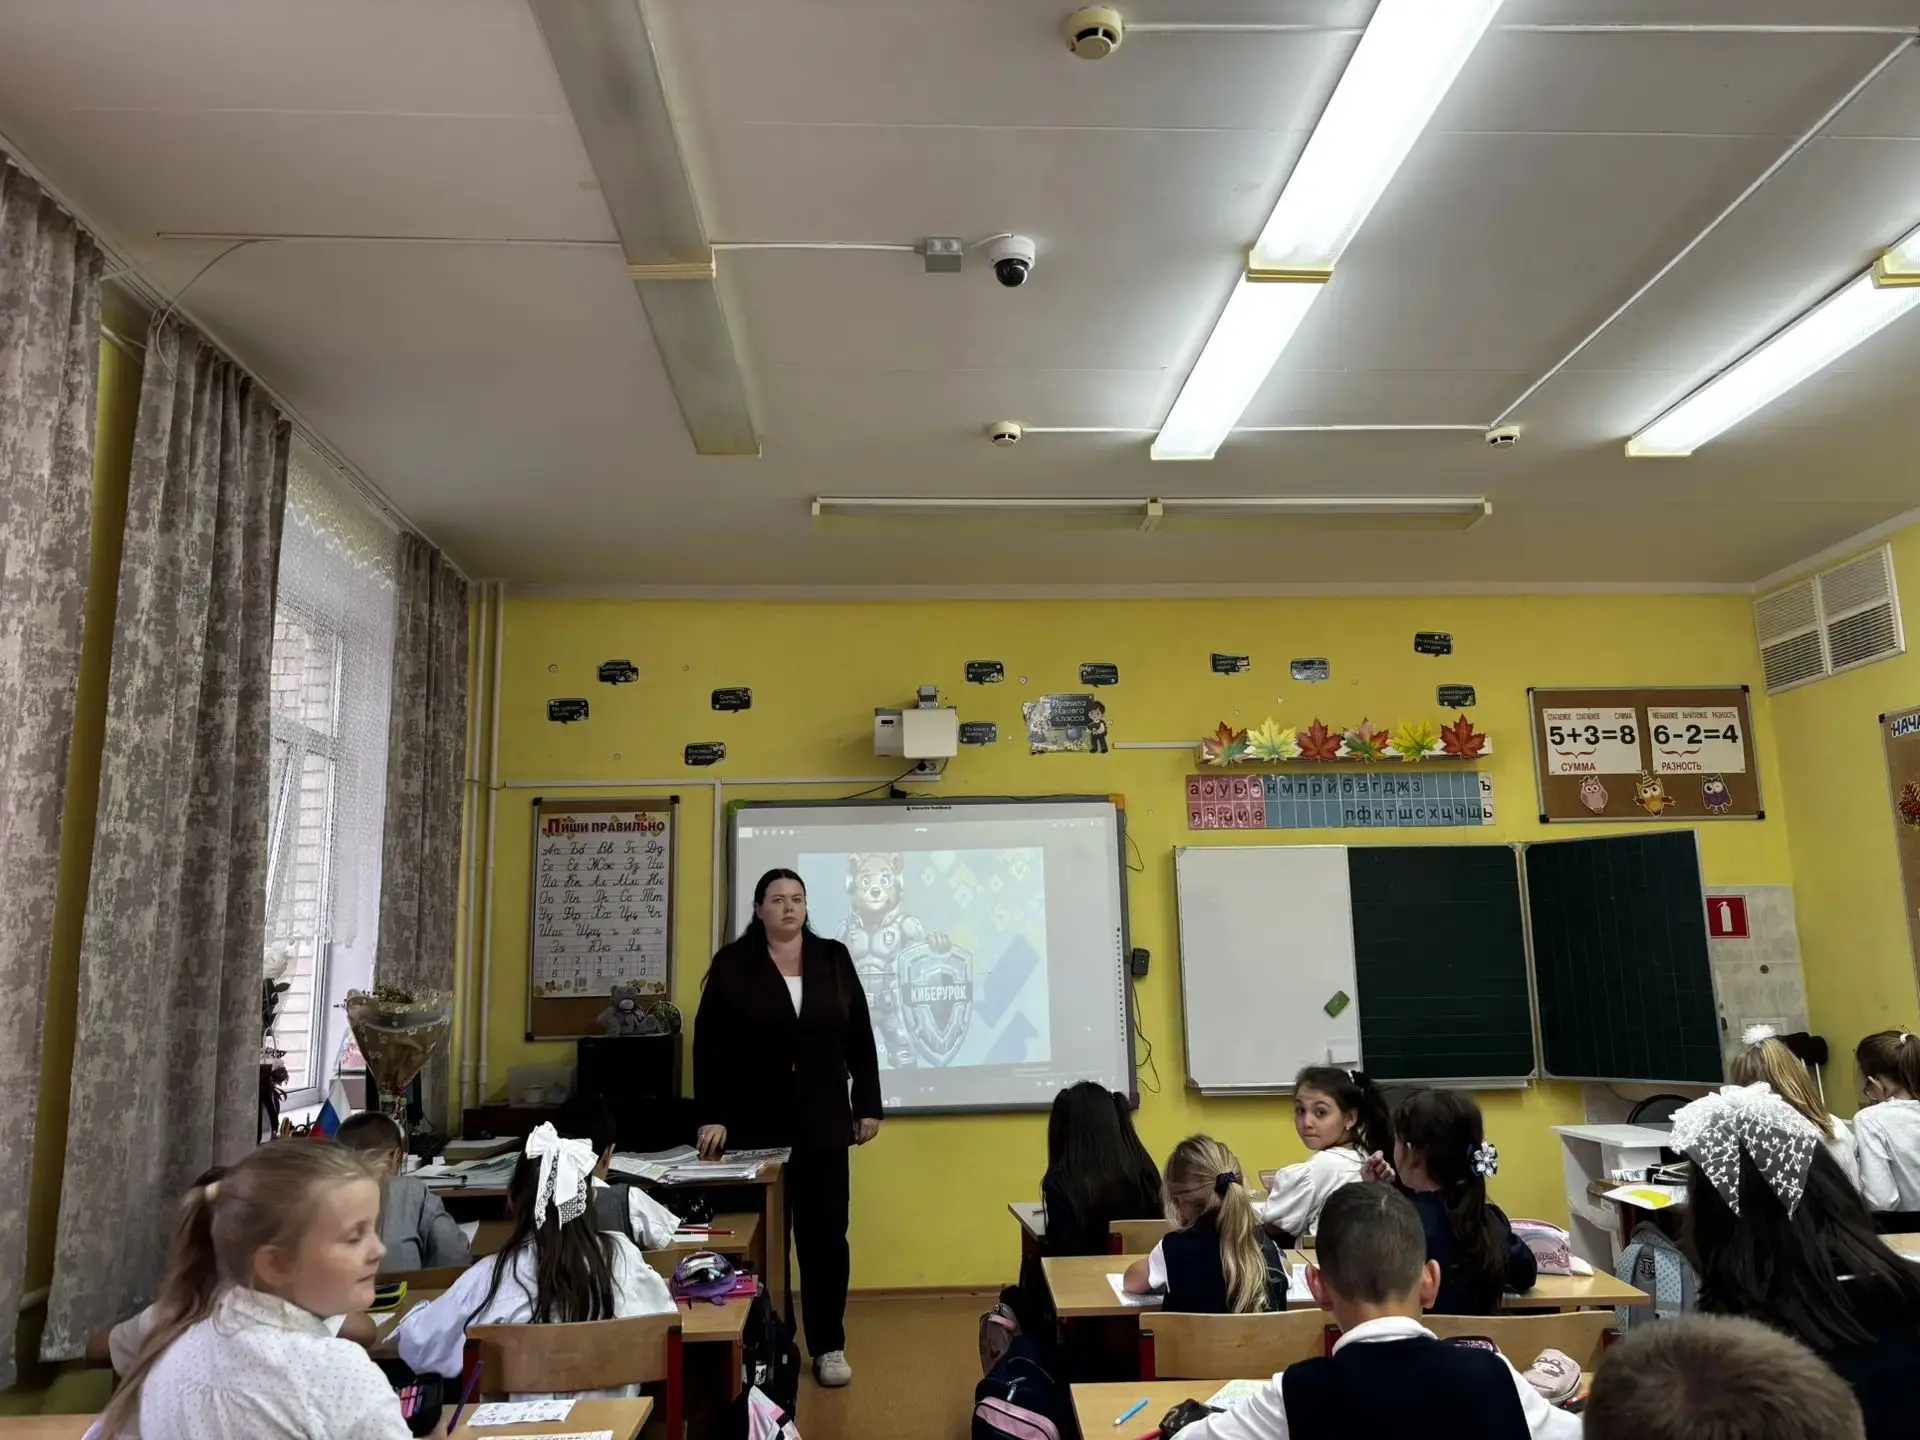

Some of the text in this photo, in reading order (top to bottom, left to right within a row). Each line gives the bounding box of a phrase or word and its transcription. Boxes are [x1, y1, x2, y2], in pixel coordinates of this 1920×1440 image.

[1614, 712, 1633, 720] СУММА
[1550, 725, 1636, 746] 5+3=8
[1654, 724, 1739, 745] 6-2=4
[1561, 762, 1596, 772] СУММА
[1661, 761, 1701, 771] РАЗНОСТЬ
[1266, 783, 1276, 794] н
[1282, 783, 1293, 793] м
[1296, 783, 1307, 793] л
[1346, 808, 1355, 820] п
[1357, 806, 1371, 825] ф
[1375, 808, 1383, 820] к
[911, 984, 967, 1004] КИБЕРУРОК
